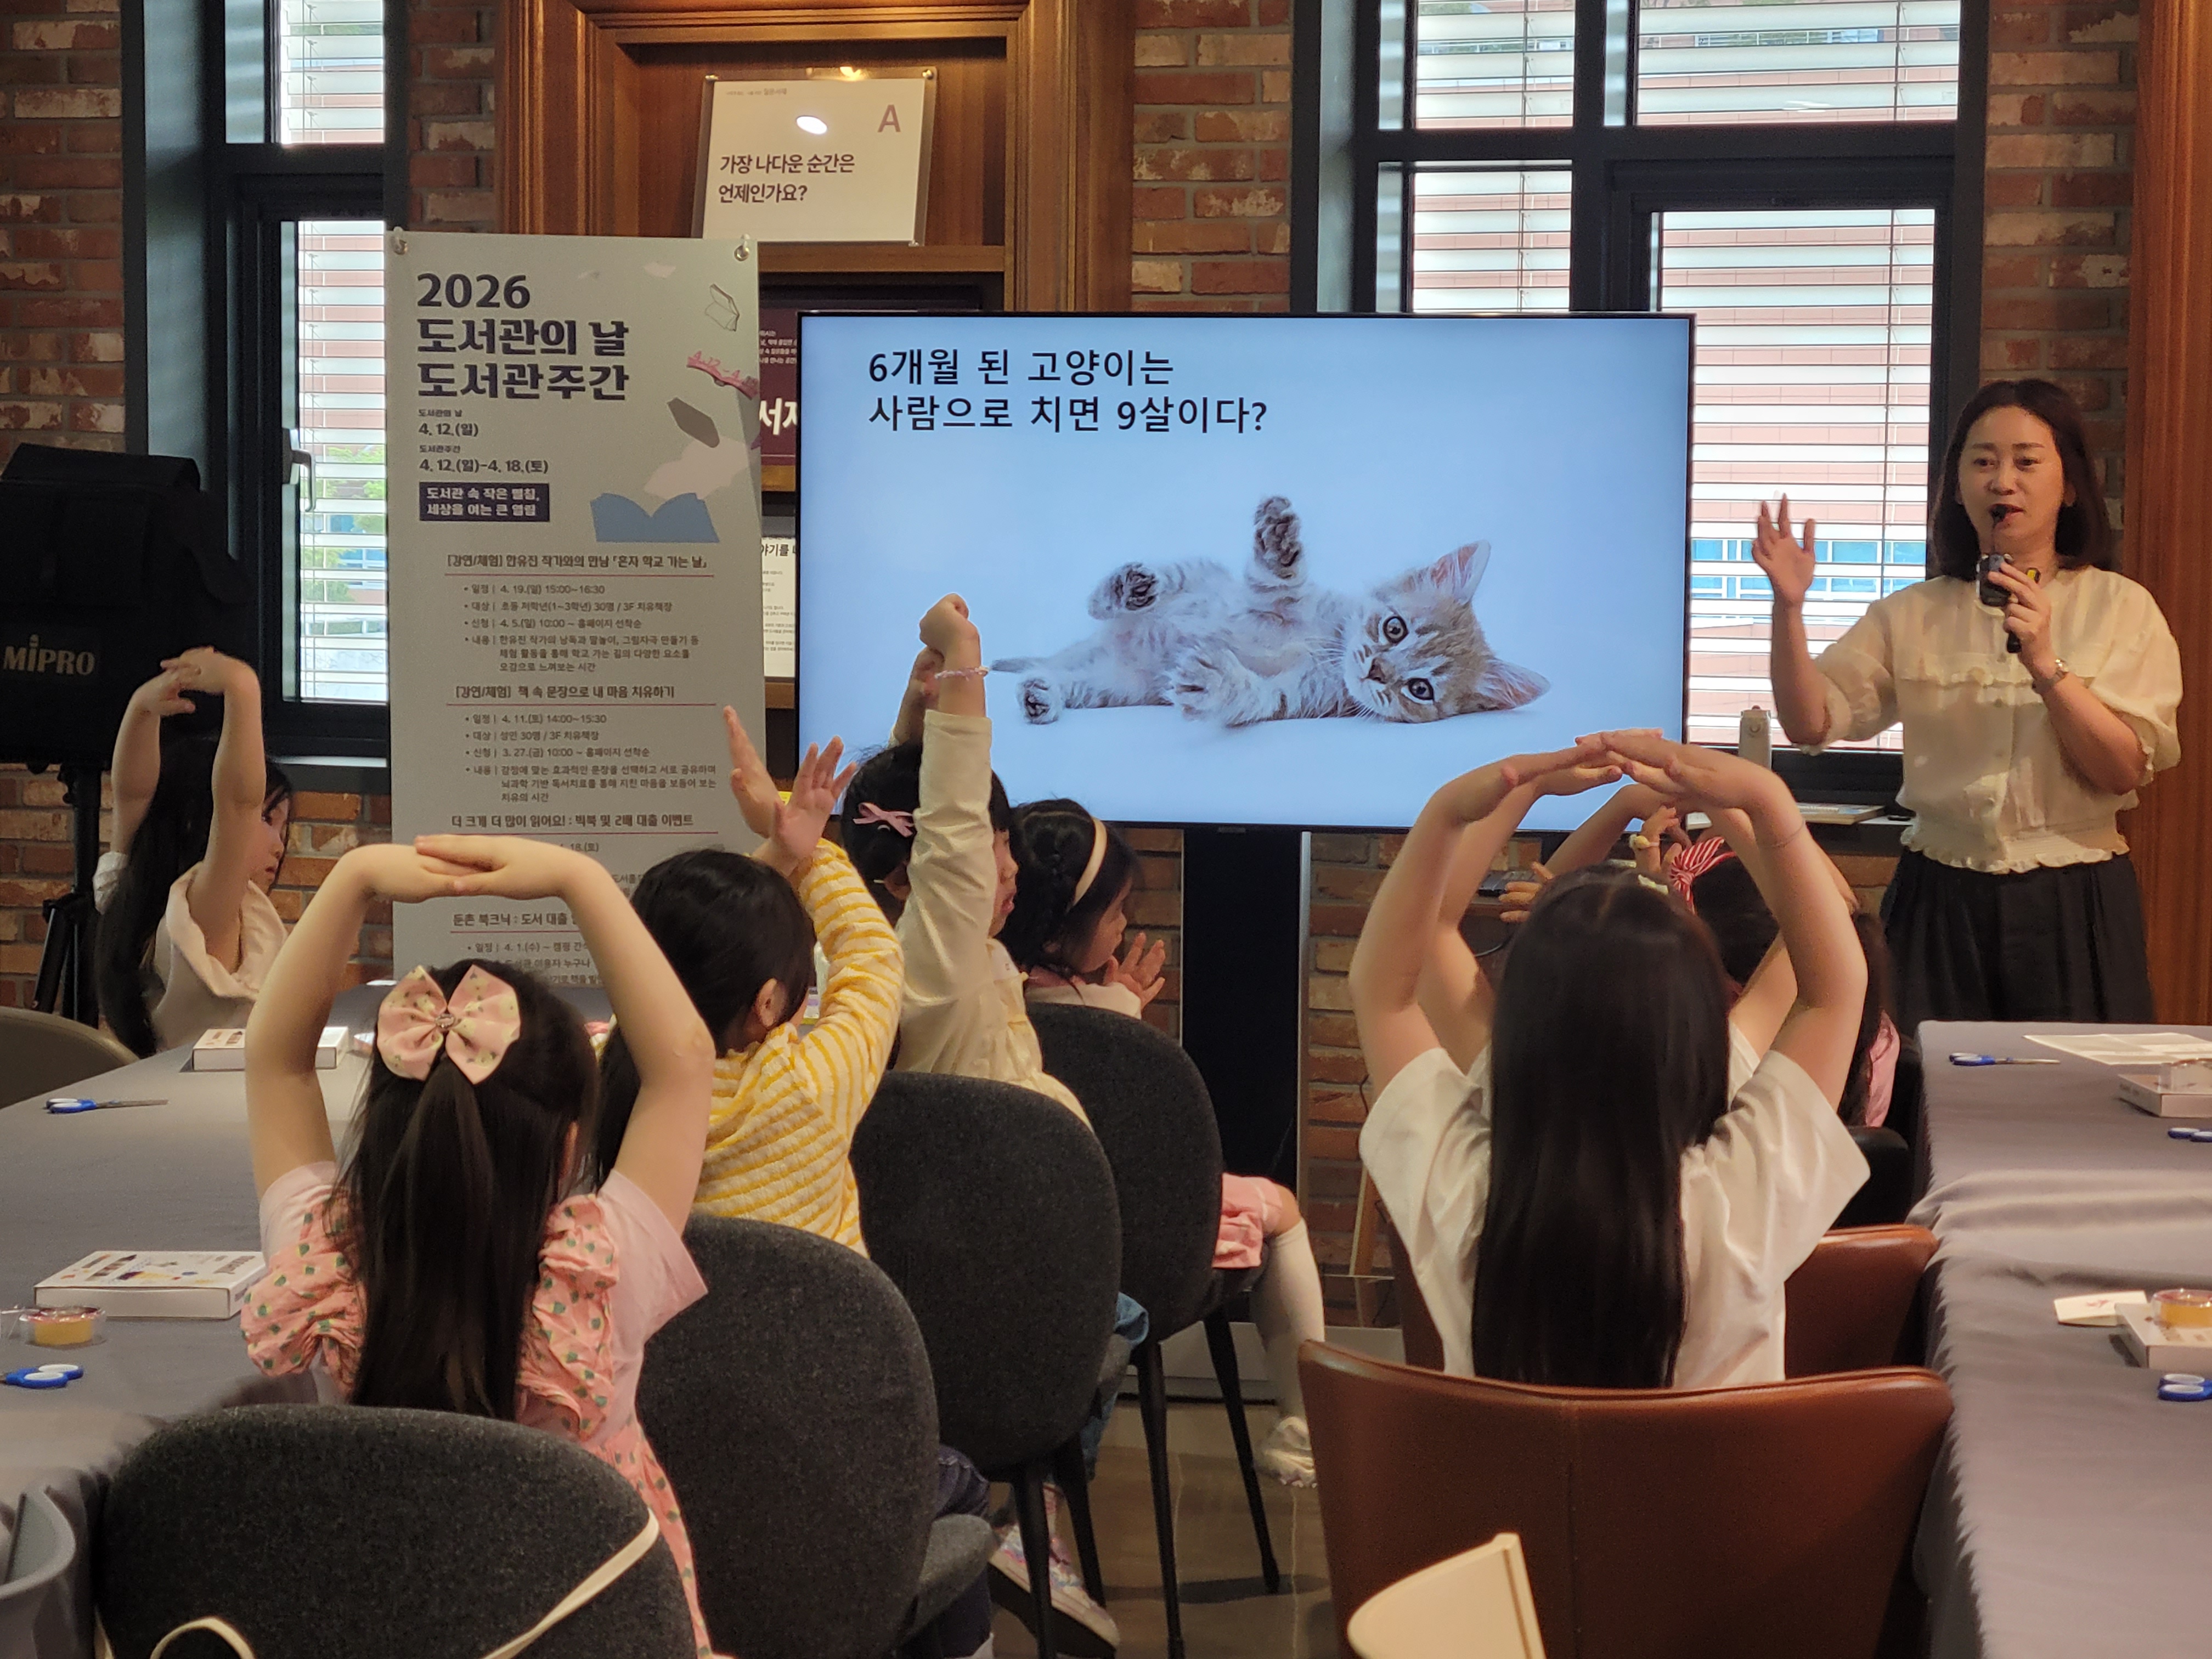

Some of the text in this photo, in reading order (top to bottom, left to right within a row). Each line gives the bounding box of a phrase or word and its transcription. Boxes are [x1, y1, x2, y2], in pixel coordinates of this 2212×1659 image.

[877, 105, 901, 132] A
[720, 154, 855, 174] 가장 나다운 순간은
[719, 184, 808, 203] 언제인가요?
[417, 273, 531, 308] 2026
[417, 319, 629, 356] 도서관의 날
[868, 348, 1175, 386] 6개월 된 고양이는
[417, 363, 630, 401] 도서관주간
[419, 409, 452, 417] 도서관의
[868, 396, 1268, 434] 사람으로 치면 9살이다?
[419, 423, 478, 437] 4. 12.(일)
[420, 445, 461, 453] 도서관주간
[420, 459, 433, 472] 4.
[505, 460, 548, 473] 18.(토)
[427, 488, 463, 499] 도서관
[467, 488, 479, 500] 속
[483, 488, 507, 500] 작은
[427, 504, 463, 516] 세상을
[467, 504, 492, 516] 여는
[496, 505, 508, 516] 큰
[448, 555, 503, 567] [강연/체험]
[506, 555, 538, 567] 한유진
[541, 556, 584, 567] 작가와의
[588, 556, 609, 567] 만남
[642, 556, 664, 568] 학교
[667, 556, 689, 568] 가는
[471, 584, 489, 594] 일정
[513, 585, 541, 595] 19.(일)
[472, 602, 489, 611] 대상
[594, 602, 614, 612] 30명
[637, 602, 672, 612] 치유책장
[472, 619, 489, 628] 신청
[616, 619, 642, 629] 선착순
[472, 636, 490, 645] 내용
[499, 636, 526, 645] 한유진
[529, 635, 556, 645] 작가의
[661, 636, 687, 645] 만들기
[592, 649, 610, 658] 가는
[634, 650, 660, 658] 다양한
[578, 663, 596, 672] 시간
[456, 686, 674, 698] [강연/체험] 책 속 문장으로 내 마음 치유하기
[473, 714, 490, 724] 일정
[515, 715, 543, 724] 11.(토)
[473, 732, 490, 741] 대상
[500, 732, 517, 741] 성인
[521, 732, 540, 741] 30명
[564, 732, 599, 741] 치유책장
[473, 748, 490, 757] 신청
[624, 748, 650, 757] 선착순
[474, 766, 490, 775] 내용
[501, 766, 528, 775] 감정에
[591, 766, 617, 775] 문장을
[661, 765, 678, 774] 서로
[501, 780, 528, 788] 뇌과학
[532, 780, 549, 788] 기반
[620, 779, 637, 788] 지친
[699, 779, 716, 788] 보는
[501, 793, 549, 802] 치유의 시간
[452, 816, 461, 827] 더
[465, 816, 487, 827] 크게
[492, 816, 501, 827] 더
[505, 815, 526, 827] 많이
[530, 815, 565, 827] 읽어요!
[575, 815, 597, 827] 빅북
[637, 814, 658, 826] 대출
[662, 814, 693, 826] 이벤트
[453, 914, 474, 926] 둔촌
[478, 913, 510, 926] 북크닉
[522, 913, 542, 926] 도서
[546, 913, 567, 926] 대출
[475, 943, 493, 953] 일정
